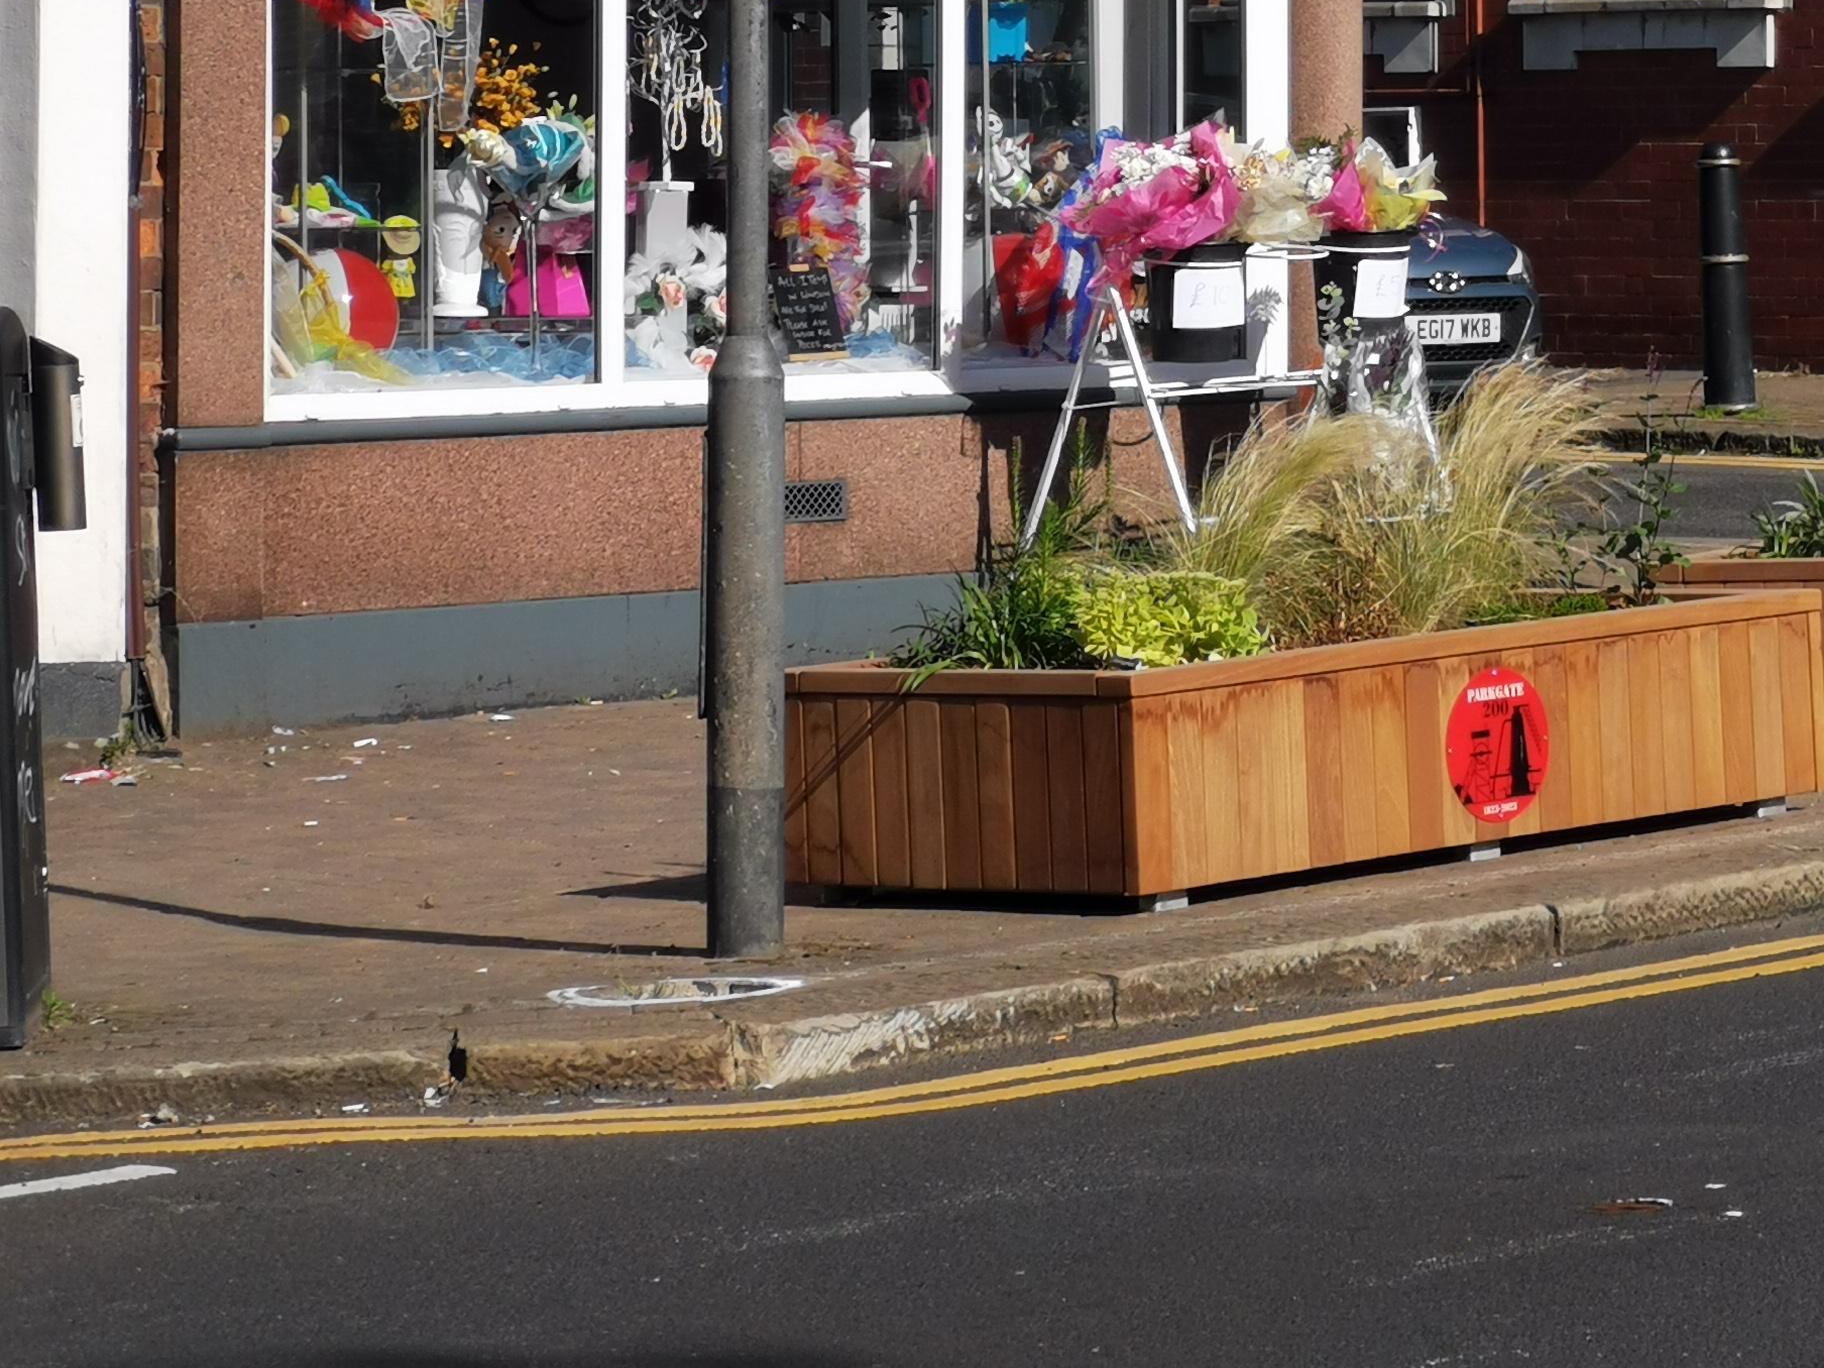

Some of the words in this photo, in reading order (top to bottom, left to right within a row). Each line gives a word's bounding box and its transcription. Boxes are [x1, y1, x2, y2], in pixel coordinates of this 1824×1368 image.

[1416, 319, 1455, 340] EG17
[1461, 317, 1491, 339] WKB
[1466, 681, 1525, 703] PARKGATE
[1482, 699, 1509, 718] 200
